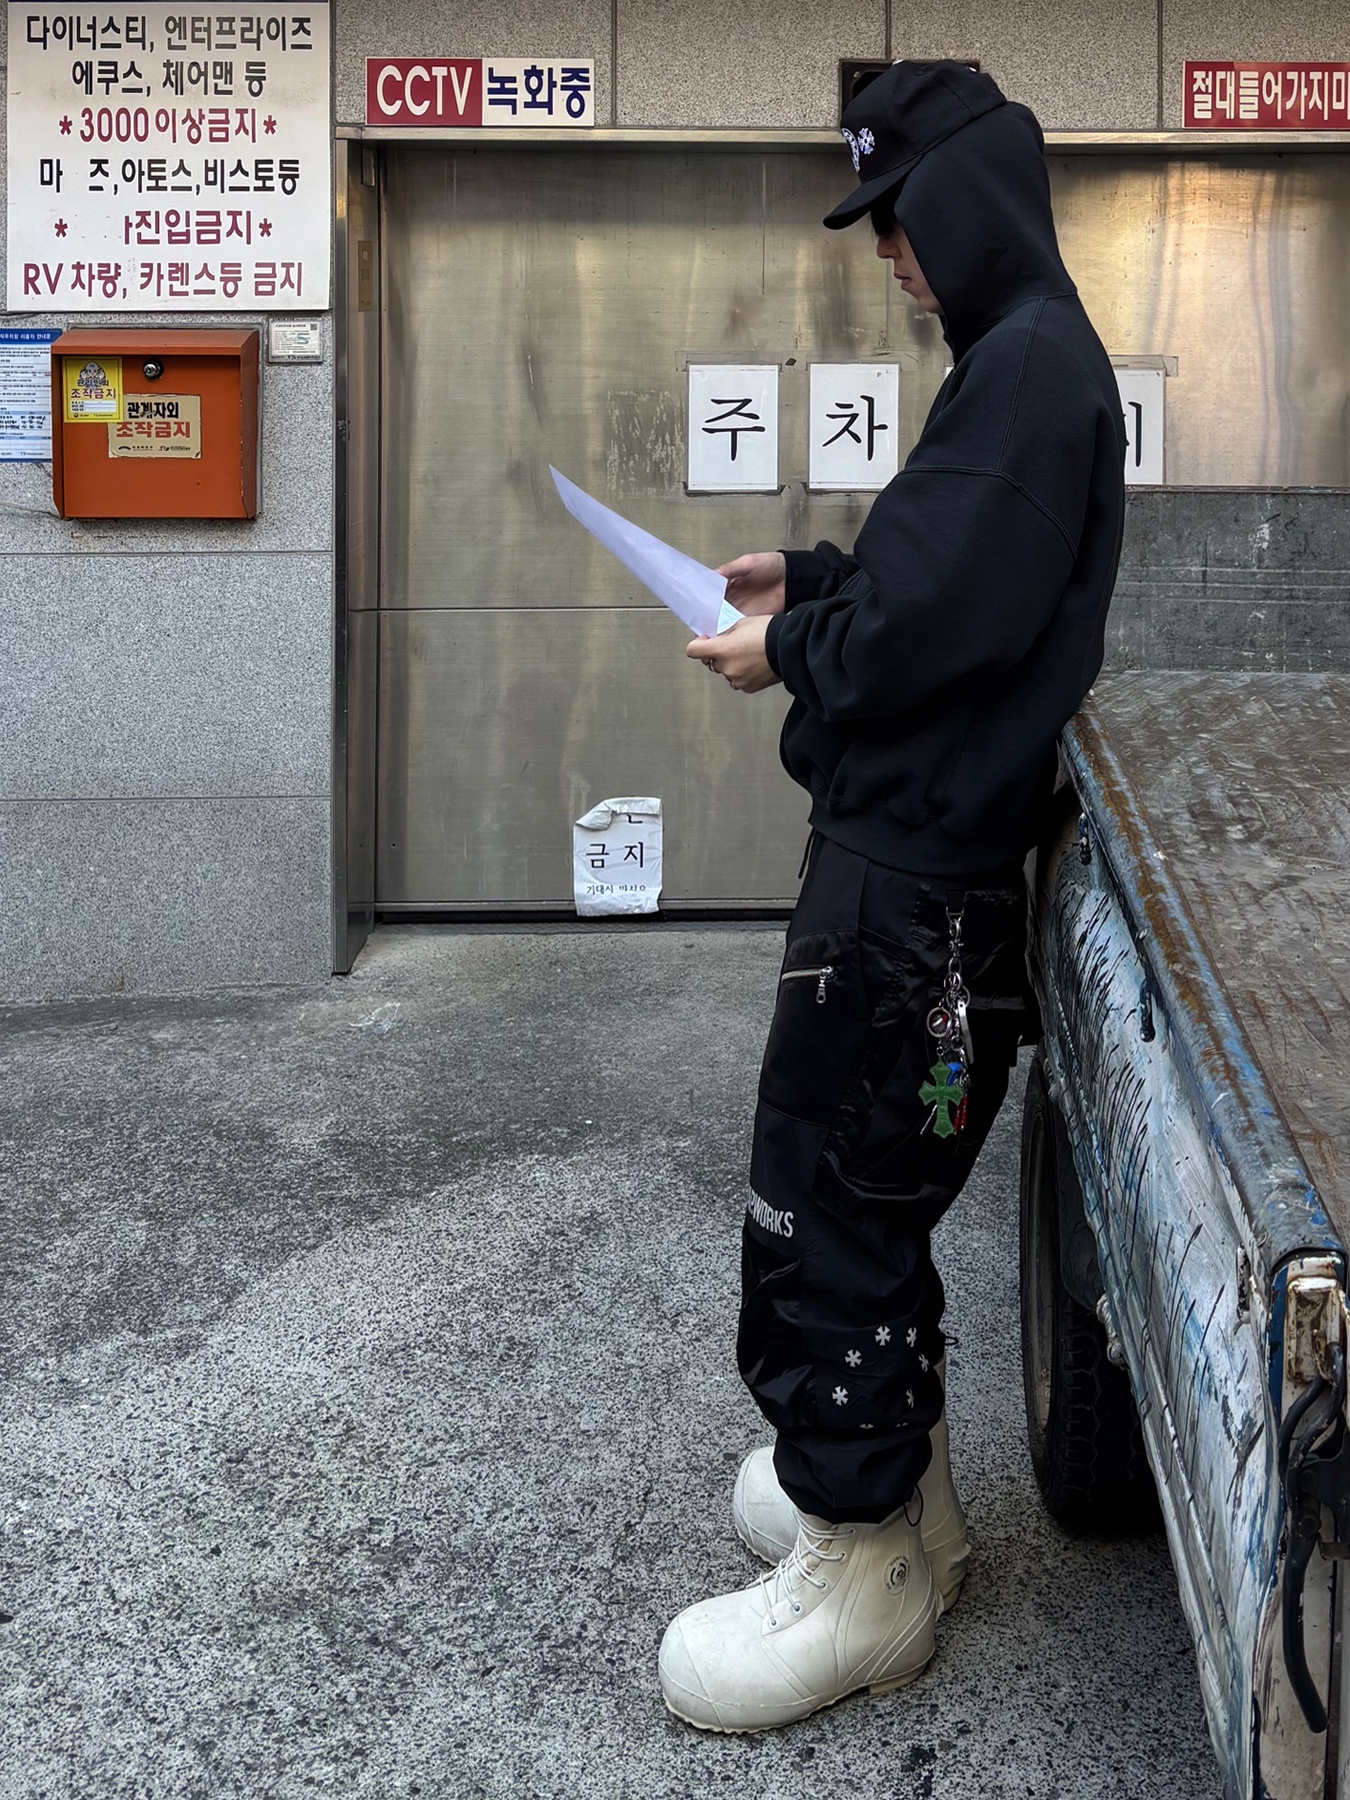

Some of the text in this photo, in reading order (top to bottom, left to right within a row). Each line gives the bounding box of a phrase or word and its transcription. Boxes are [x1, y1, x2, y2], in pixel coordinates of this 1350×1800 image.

[26, 15, 313, 52] 다이너스티, 엔터프라이즈
[71, 59, 267, 98] 에쿠스, 체어맨 등
[376, 64, 591, 119] CCTV 녹화중
[23, 261, 303, 300] RV 차량, 카렌스등 금지
[70, 388, 117, 400] 조작금지
[116, 421, 191, 439] 조작금지
